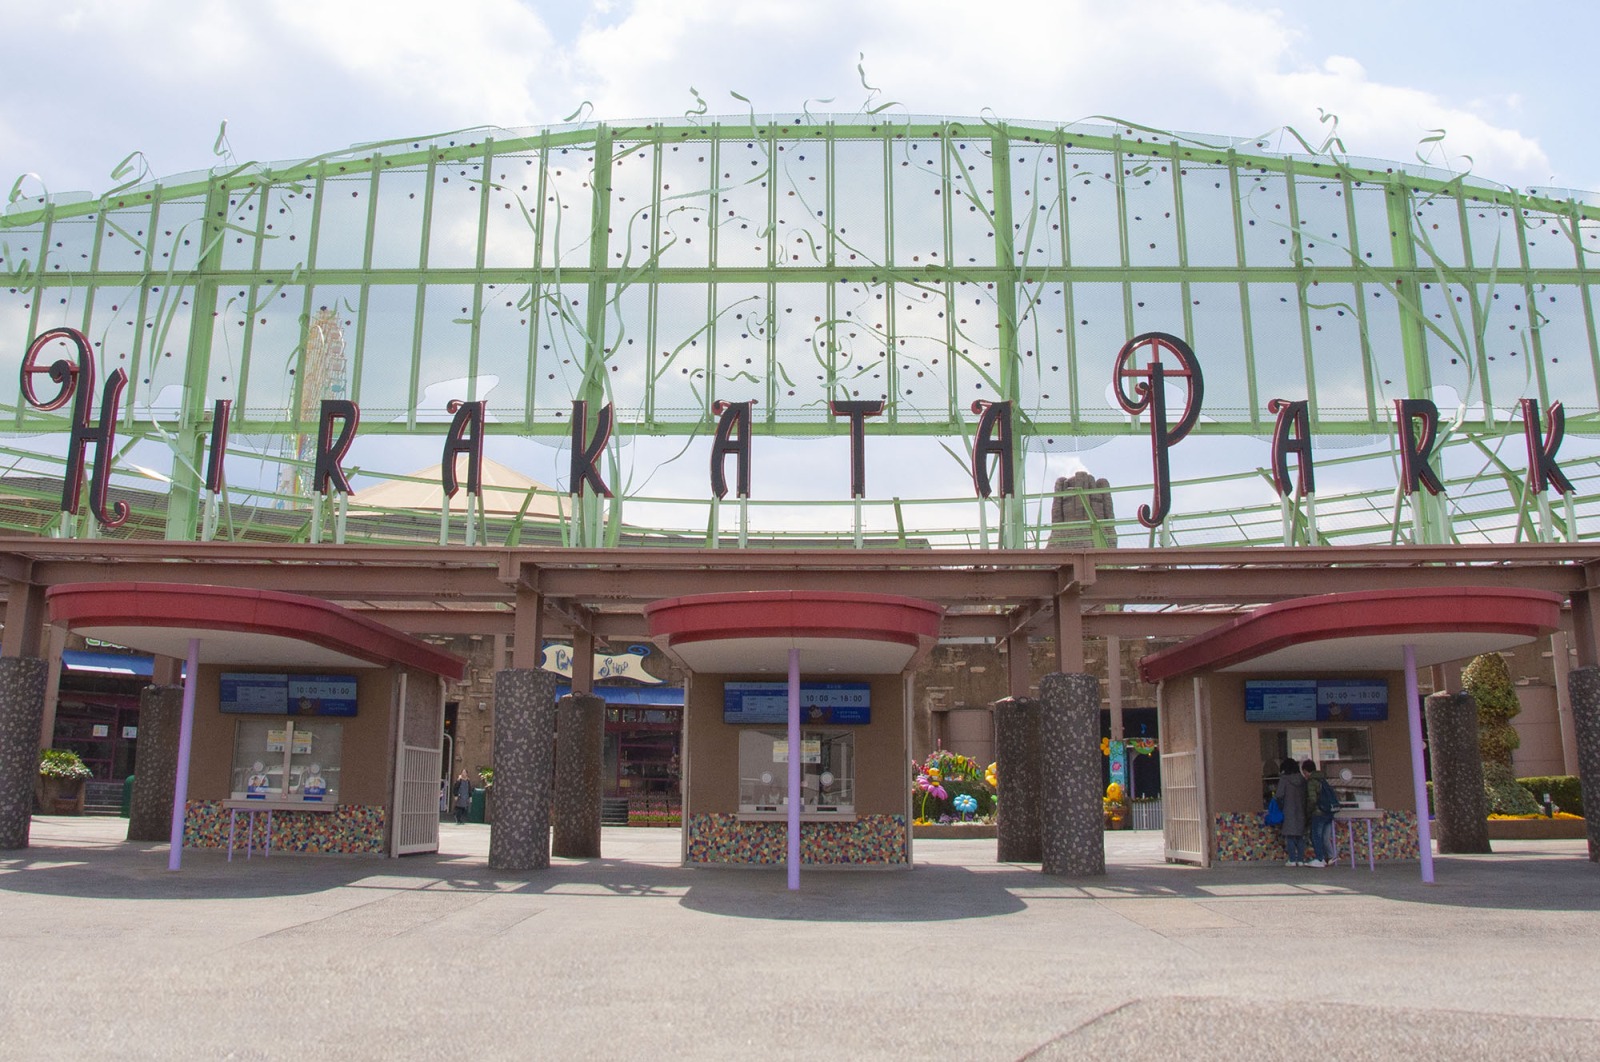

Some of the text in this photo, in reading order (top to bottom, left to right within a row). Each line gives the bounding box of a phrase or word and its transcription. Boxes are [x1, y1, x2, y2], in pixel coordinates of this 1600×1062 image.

[20, 326, 1577, 529] HIRAKATA PARK
[598, 657, 629, 677] SHOP
[806, 694, 828, 702] 10:00
